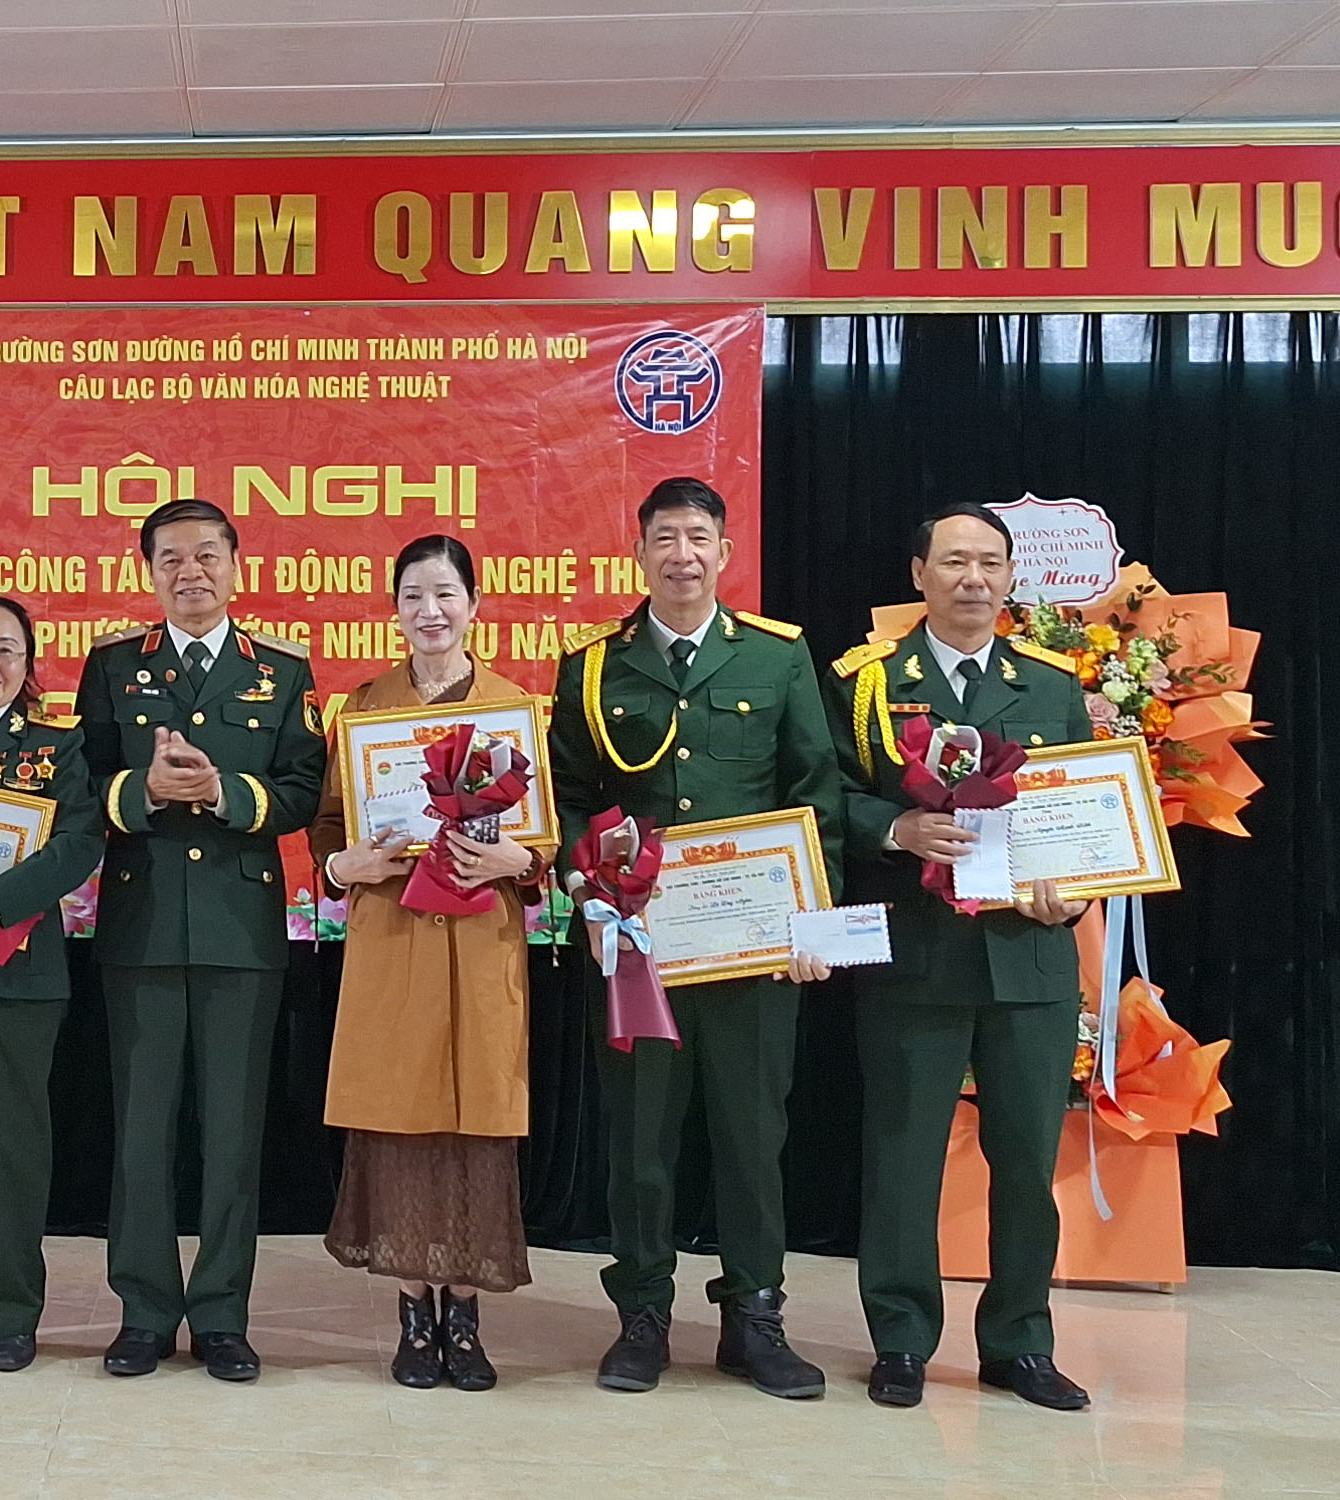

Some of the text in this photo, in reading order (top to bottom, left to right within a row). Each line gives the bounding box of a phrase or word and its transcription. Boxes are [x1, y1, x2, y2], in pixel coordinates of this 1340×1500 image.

[73, 194, 317, 277] NAM
[373, 188, 756, 284] QUANG
[814, 183, 1088, 270] VINH
[1149, 181, 1340, 268] MU
[72, 338, 119, 363] SƠN
[126, 336, 205, 363] ĐƯỜNG
[212, 332, 243, 362] HỒ
[250, 335, 289, 361] CHÍ
[297, 338, 359, 361] MINH
[366, 334, 444, 361] THÀNH
[451, 330, 500, 361] PHỐ
[506, 333, 539, 360] HÀ
[546, 333, 588, 364] NỘI
[59, 372, 451, 404] CÂU LẠC BỘ VĂN HÓA NGHỆ THUẬT
[32, 452, 476, 529] HỘI NGHỊ
[1012, 526, 1090, 540] RƯỜNG SƠN
[1040, 540, 1064, 553] CHÍ
[1067, 540, 1104, 551] MINH
[274, 548, 373, 602] ĐỘNG
[482, 548, 578, 602] NGHỆ
